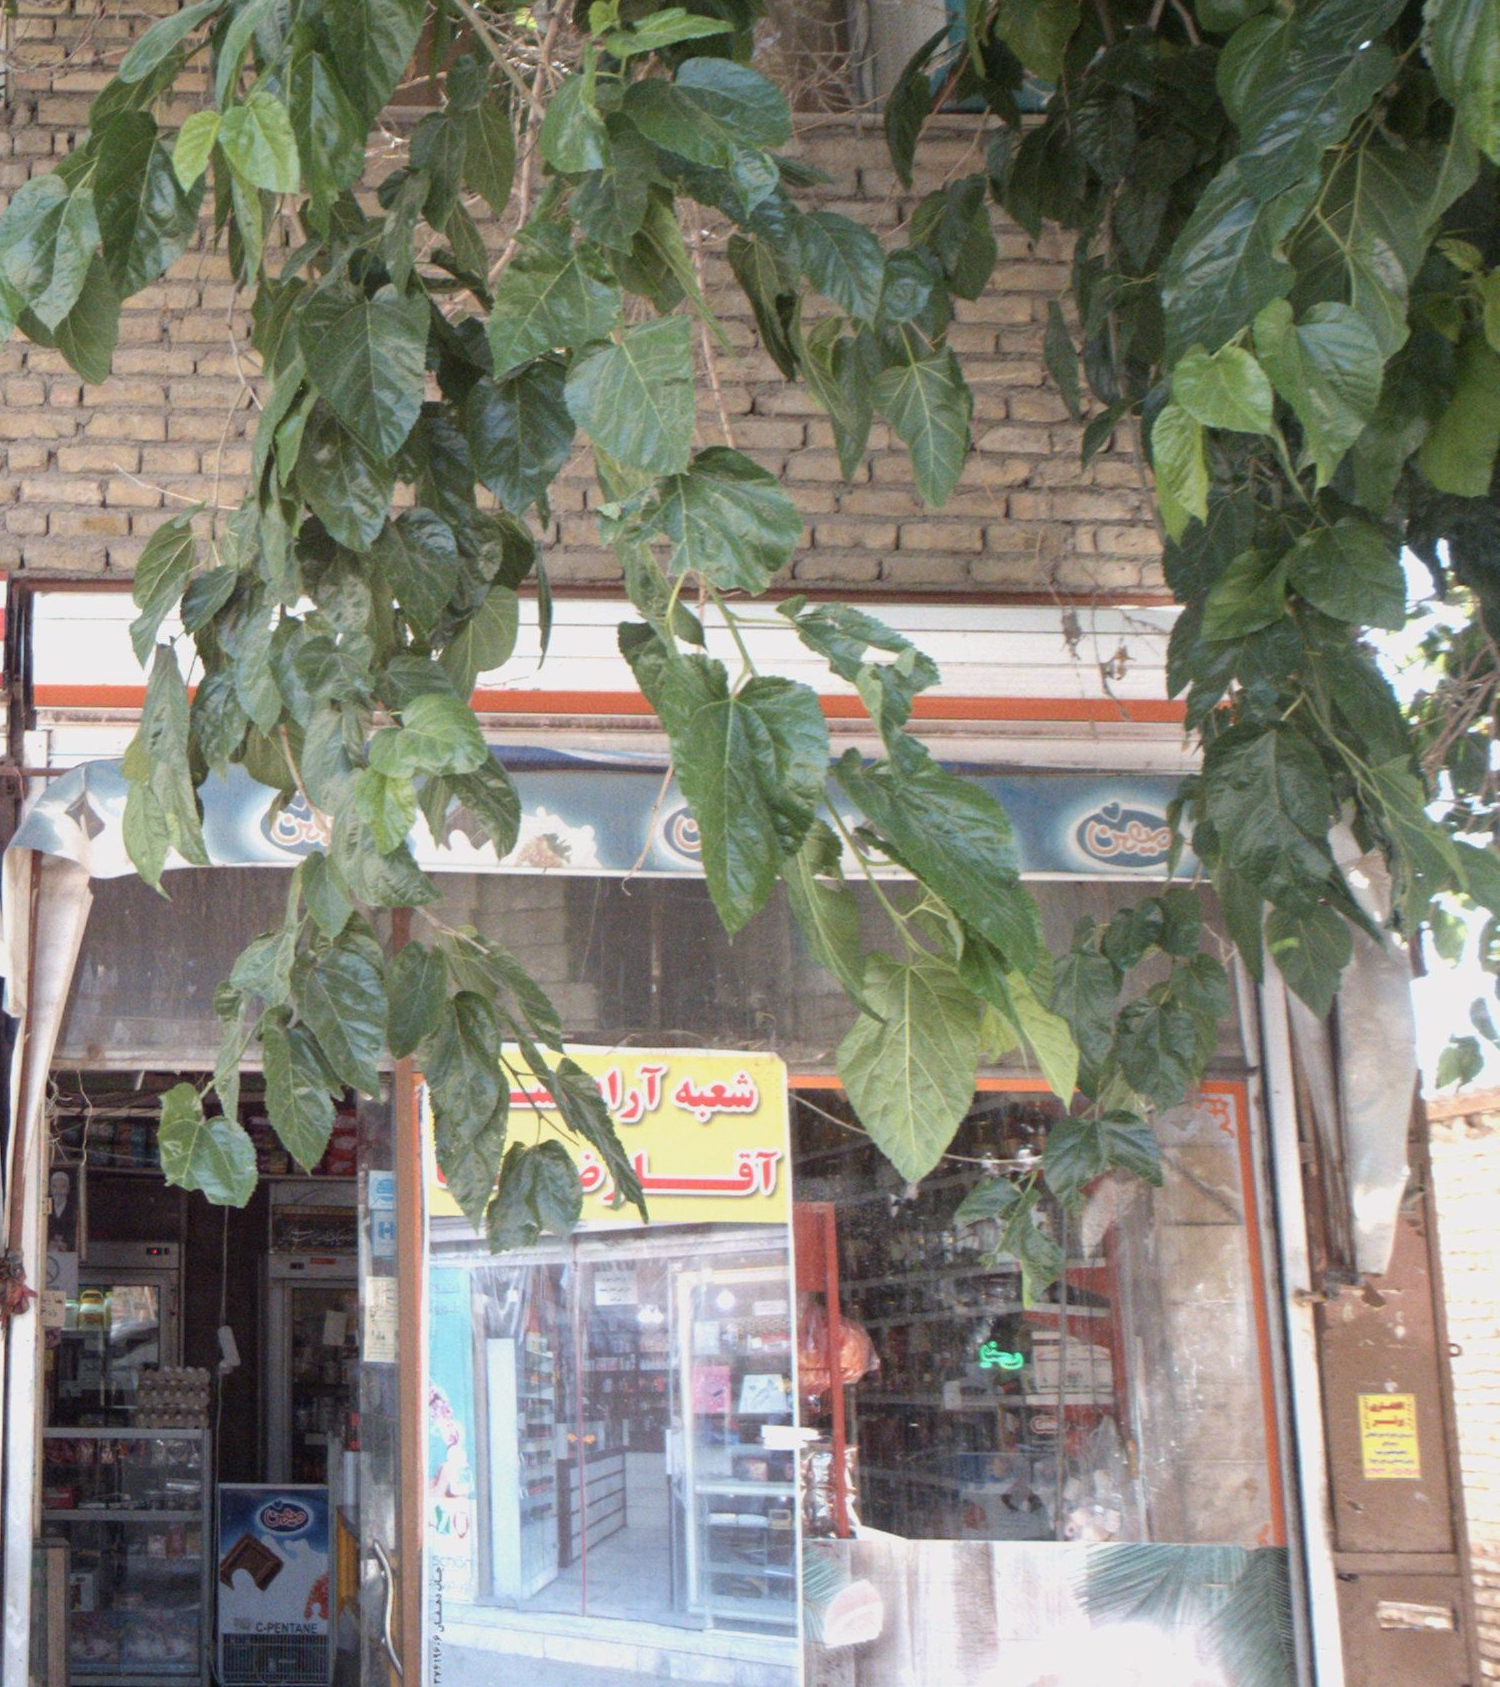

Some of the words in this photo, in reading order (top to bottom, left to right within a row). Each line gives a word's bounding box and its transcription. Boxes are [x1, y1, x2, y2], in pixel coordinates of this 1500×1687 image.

[271, 810, 334, 847] هن
[1086, 821, 1174, 857] میهن
[675, 1073, 757, 1120] شعبه
[263, 1507, 309, 1528] میهن
[255, 1621, 318, 1635] C-PENTANE
